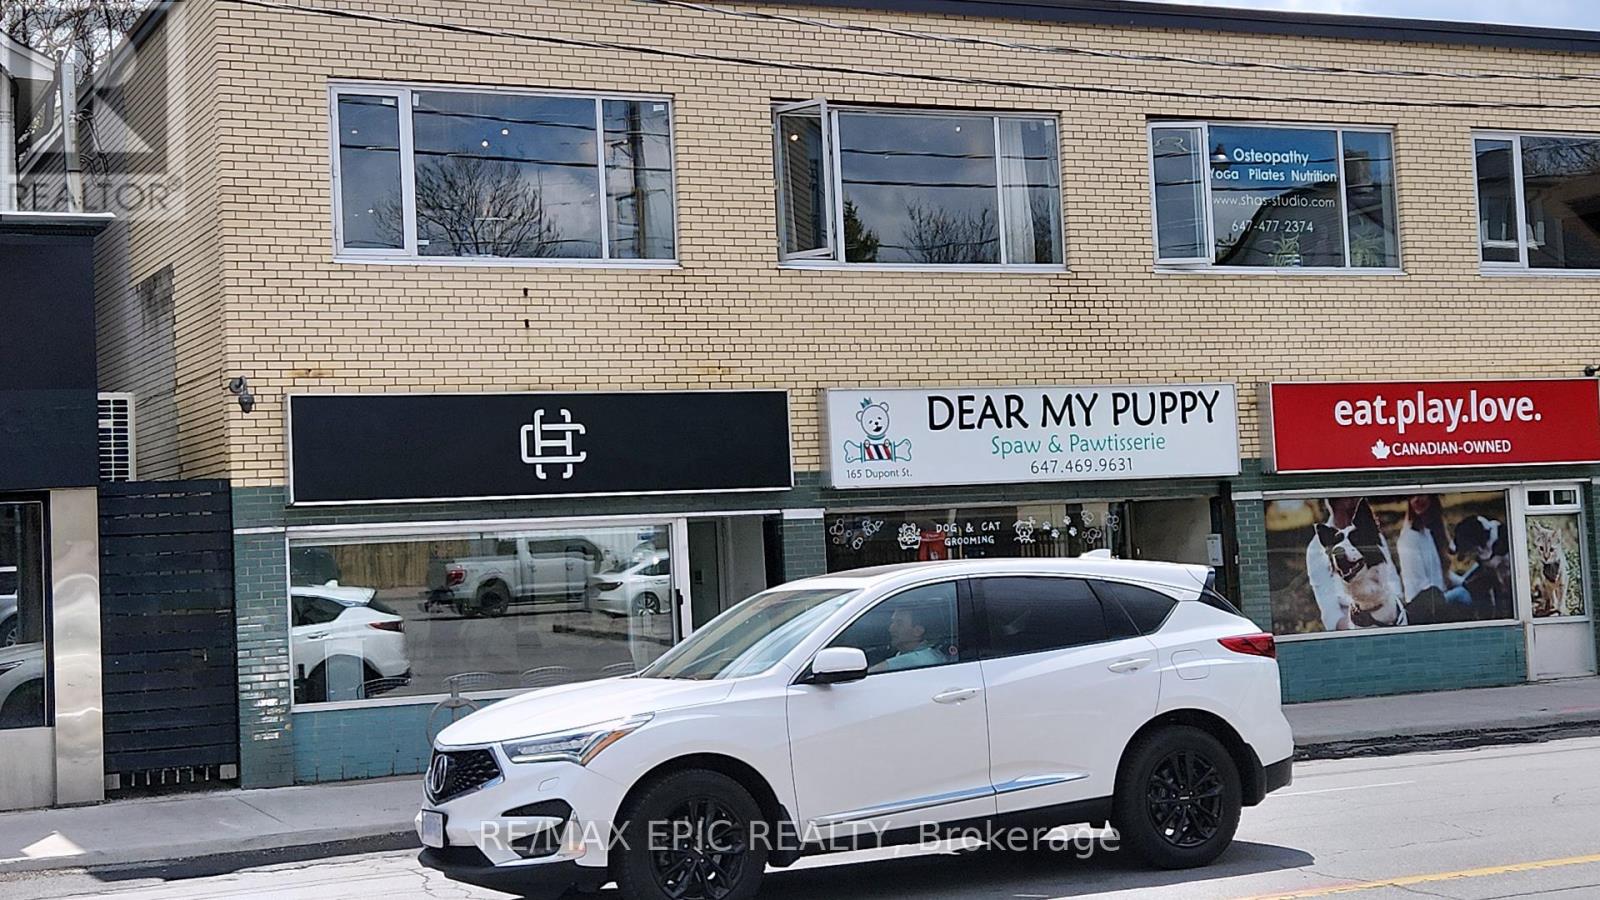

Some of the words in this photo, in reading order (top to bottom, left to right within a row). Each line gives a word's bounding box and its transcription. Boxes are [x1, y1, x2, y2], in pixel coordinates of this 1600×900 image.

[1233, 147, 1309, 167] Osteopathy
[1249, 168, 1285, 182] Pilates
[1291, 170, 1338, 183] Nutrition
[1213, 194, 1336, 208] www.shas-studio.com
[927, 394, 1029, 431] DEAR
[1040, 393, 1099, 428] MY
[1111, 390, 1220, 426] PUPPY
[1334, 389, 1542, 434] eat.play.love.
[991, 435, 1041, 459] Spaw
[1048, 434, 1063, 453] &
[1069, 433, 1166, 453] Pawtisserie
[1392, 439, 1512, 456] CANADIAN-OWNED
[846, 469, 862, 479] 165
[865, 468, 899, 480] Dupont
[901, 467, 913, 478] St.
[1030, 457, 1133, 475] 647.469.9631
[936, 523, 958, 533] DOG
[965, 522, 975, 533] &
[981, 521, 1001, 531] CAT
[944, 535, 995, 547] GROOMING
